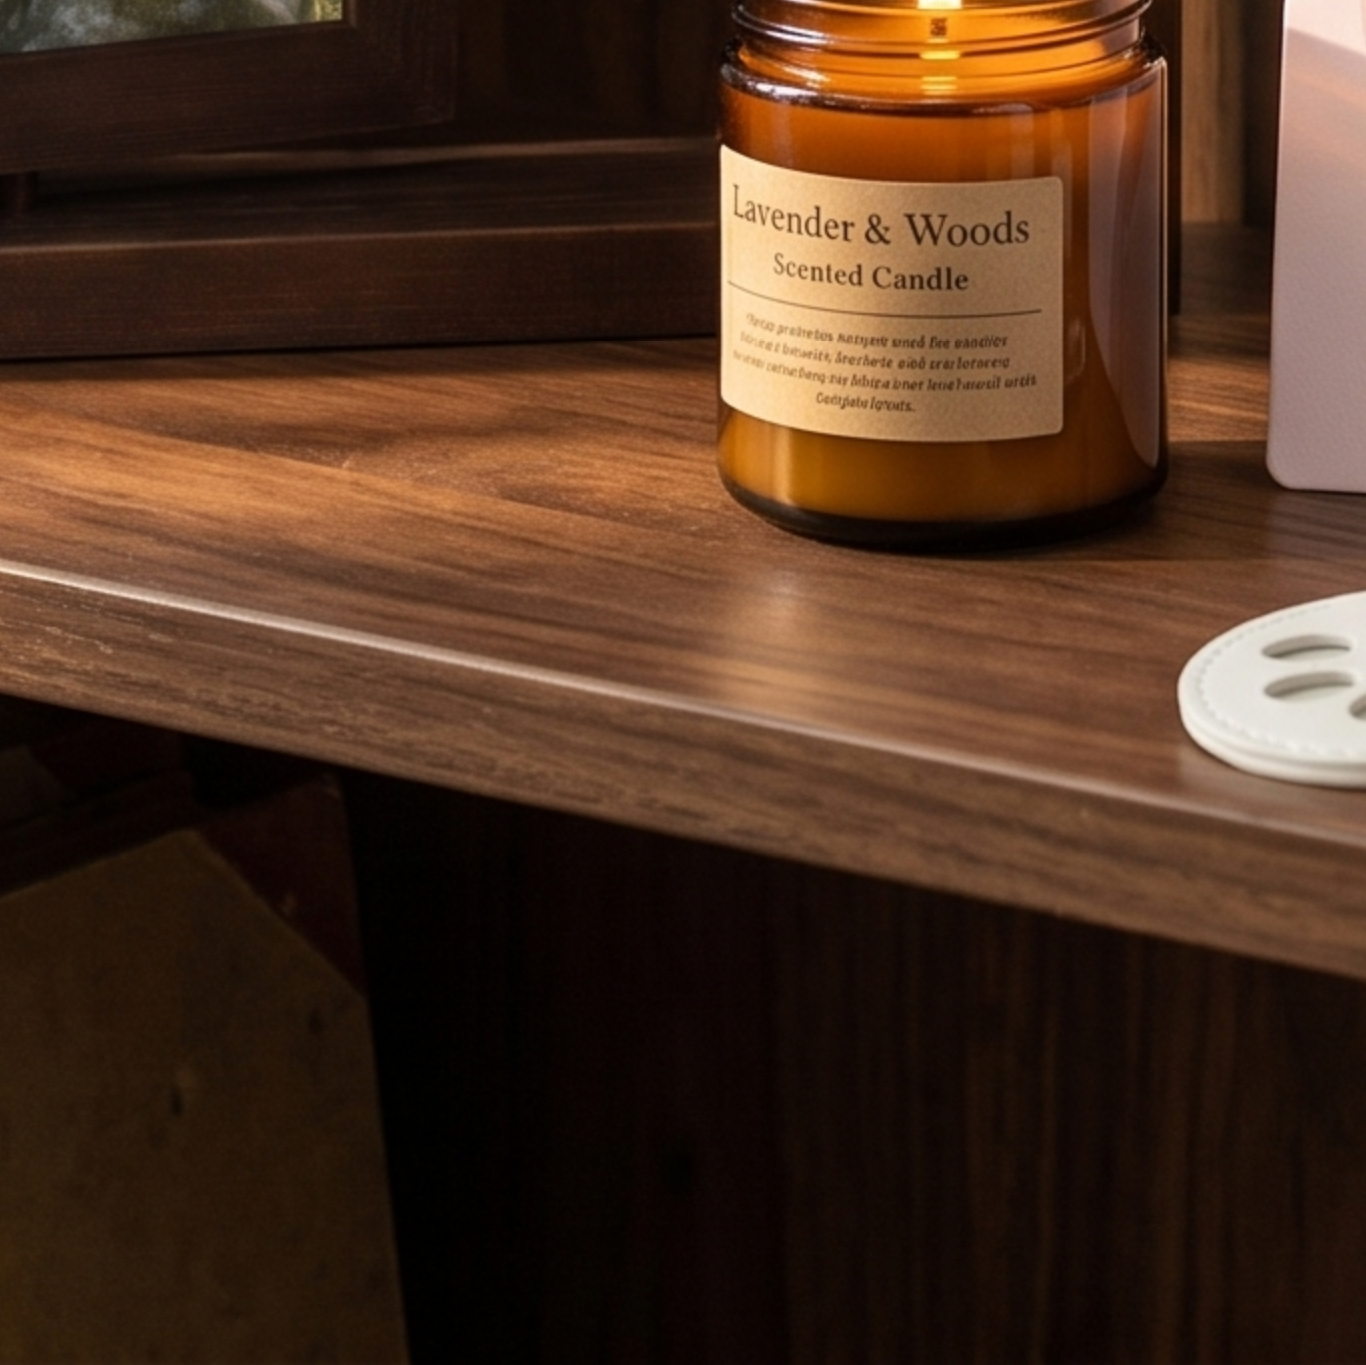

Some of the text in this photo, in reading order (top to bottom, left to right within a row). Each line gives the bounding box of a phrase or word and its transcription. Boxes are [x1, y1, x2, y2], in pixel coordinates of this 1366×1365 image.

[731, 182, 1031, 247] Lavender & Woods
[772, 252, 970, 292] Scented Candle
